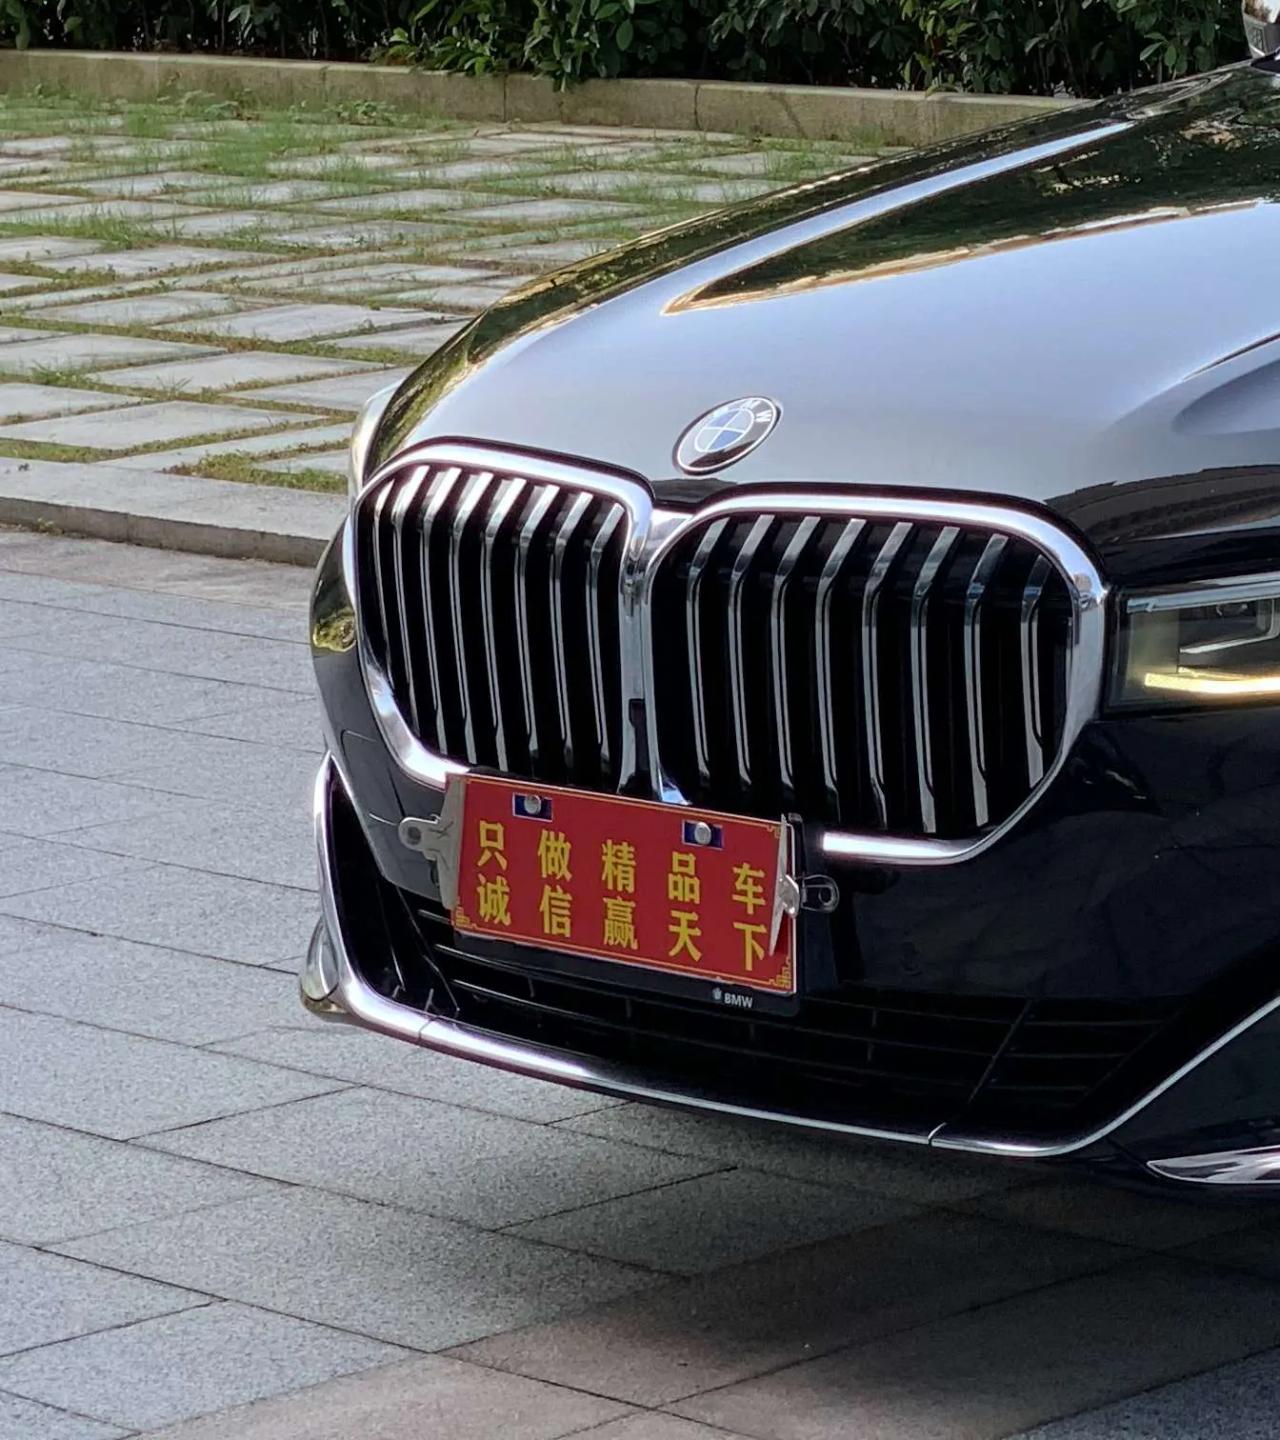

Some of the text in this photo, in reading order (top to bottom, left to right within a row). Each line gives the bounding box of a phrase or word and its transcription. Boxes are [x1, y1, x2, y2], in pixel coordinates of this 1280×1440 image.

[477, 820, 766, 915] 只做精品车
[476, 873, 767, 971] 诚信赢天下
[724, 992, 753, 1009] BMW
